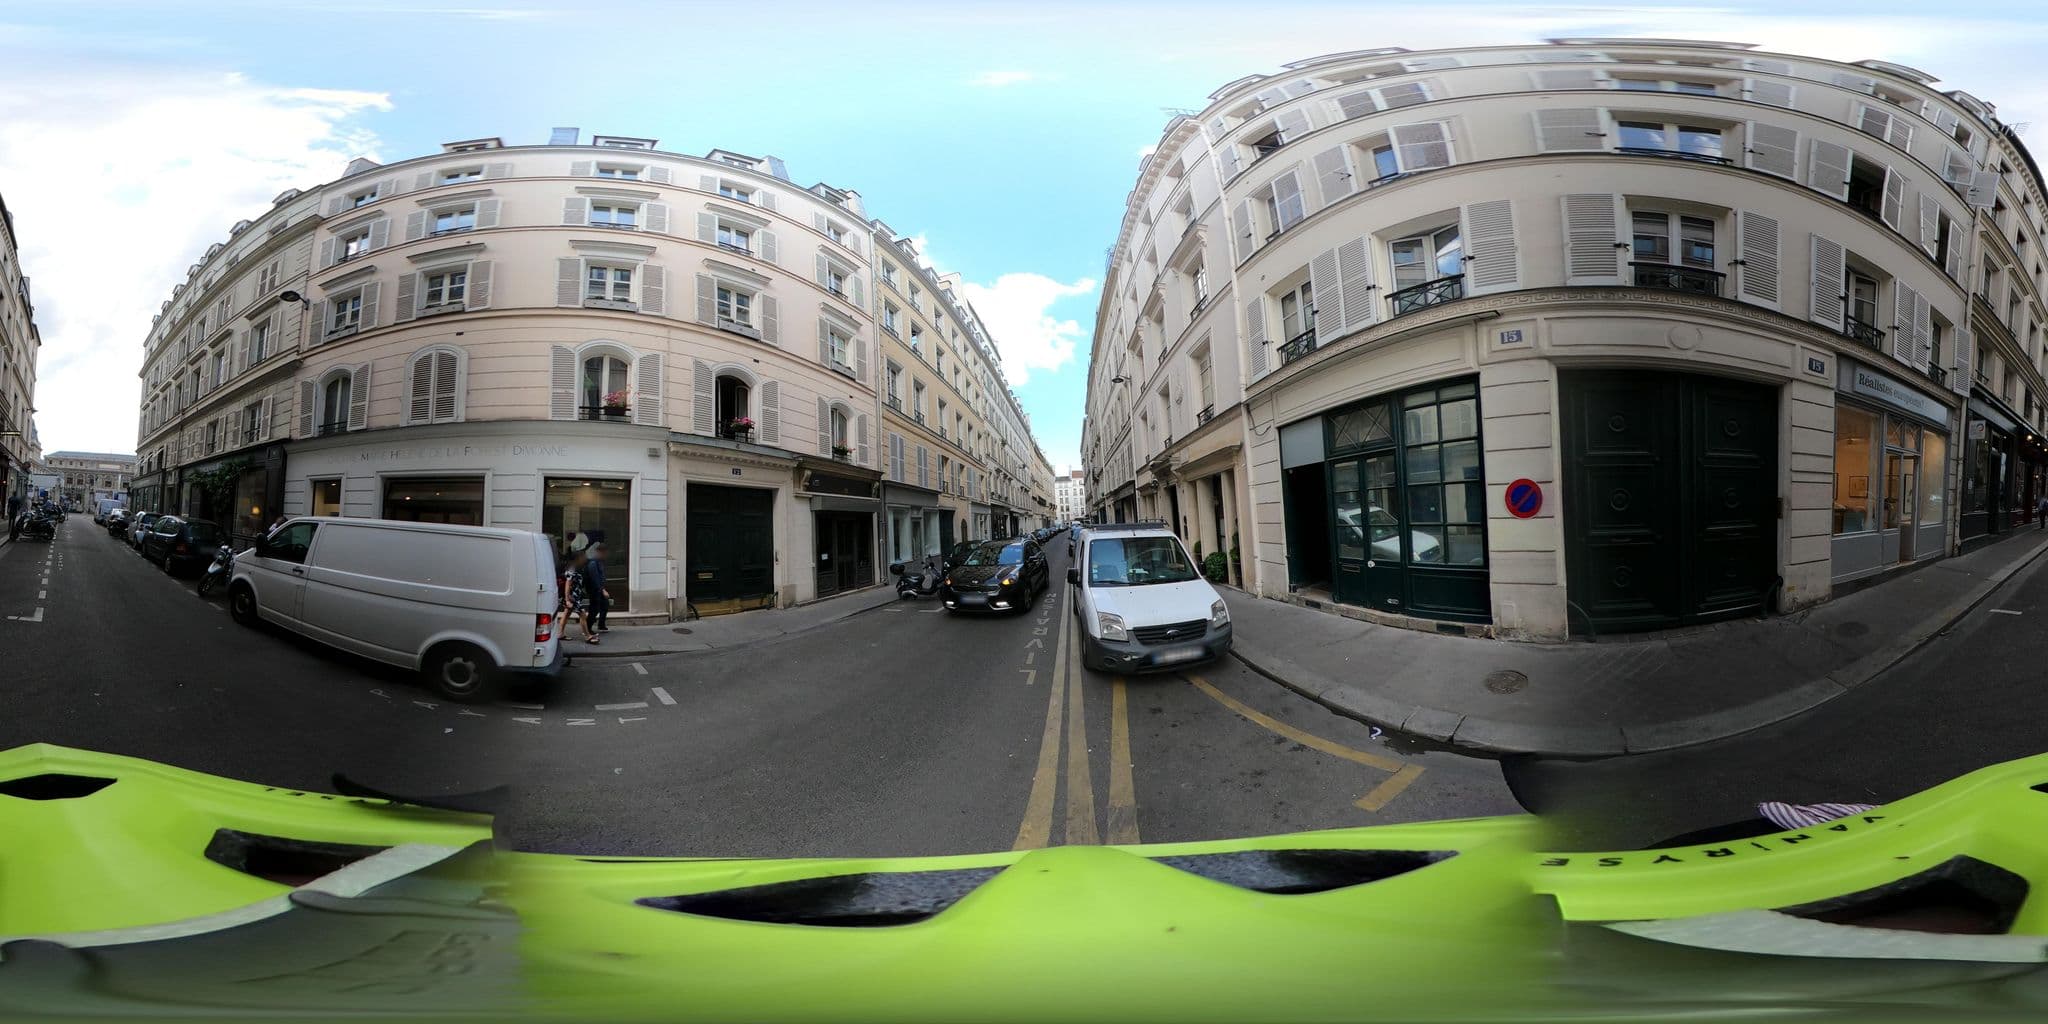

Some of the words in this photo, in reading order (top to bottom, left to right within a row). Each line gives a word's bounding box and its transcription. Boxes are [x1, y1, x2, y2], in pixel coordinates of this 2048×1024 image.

[1503, 331, 1518, 343] 15
[1812, 359, 1822, 372] 15
[1858, 373, 1893, 397] Réalistes
[368, 687, 649, 727] PAYANT
